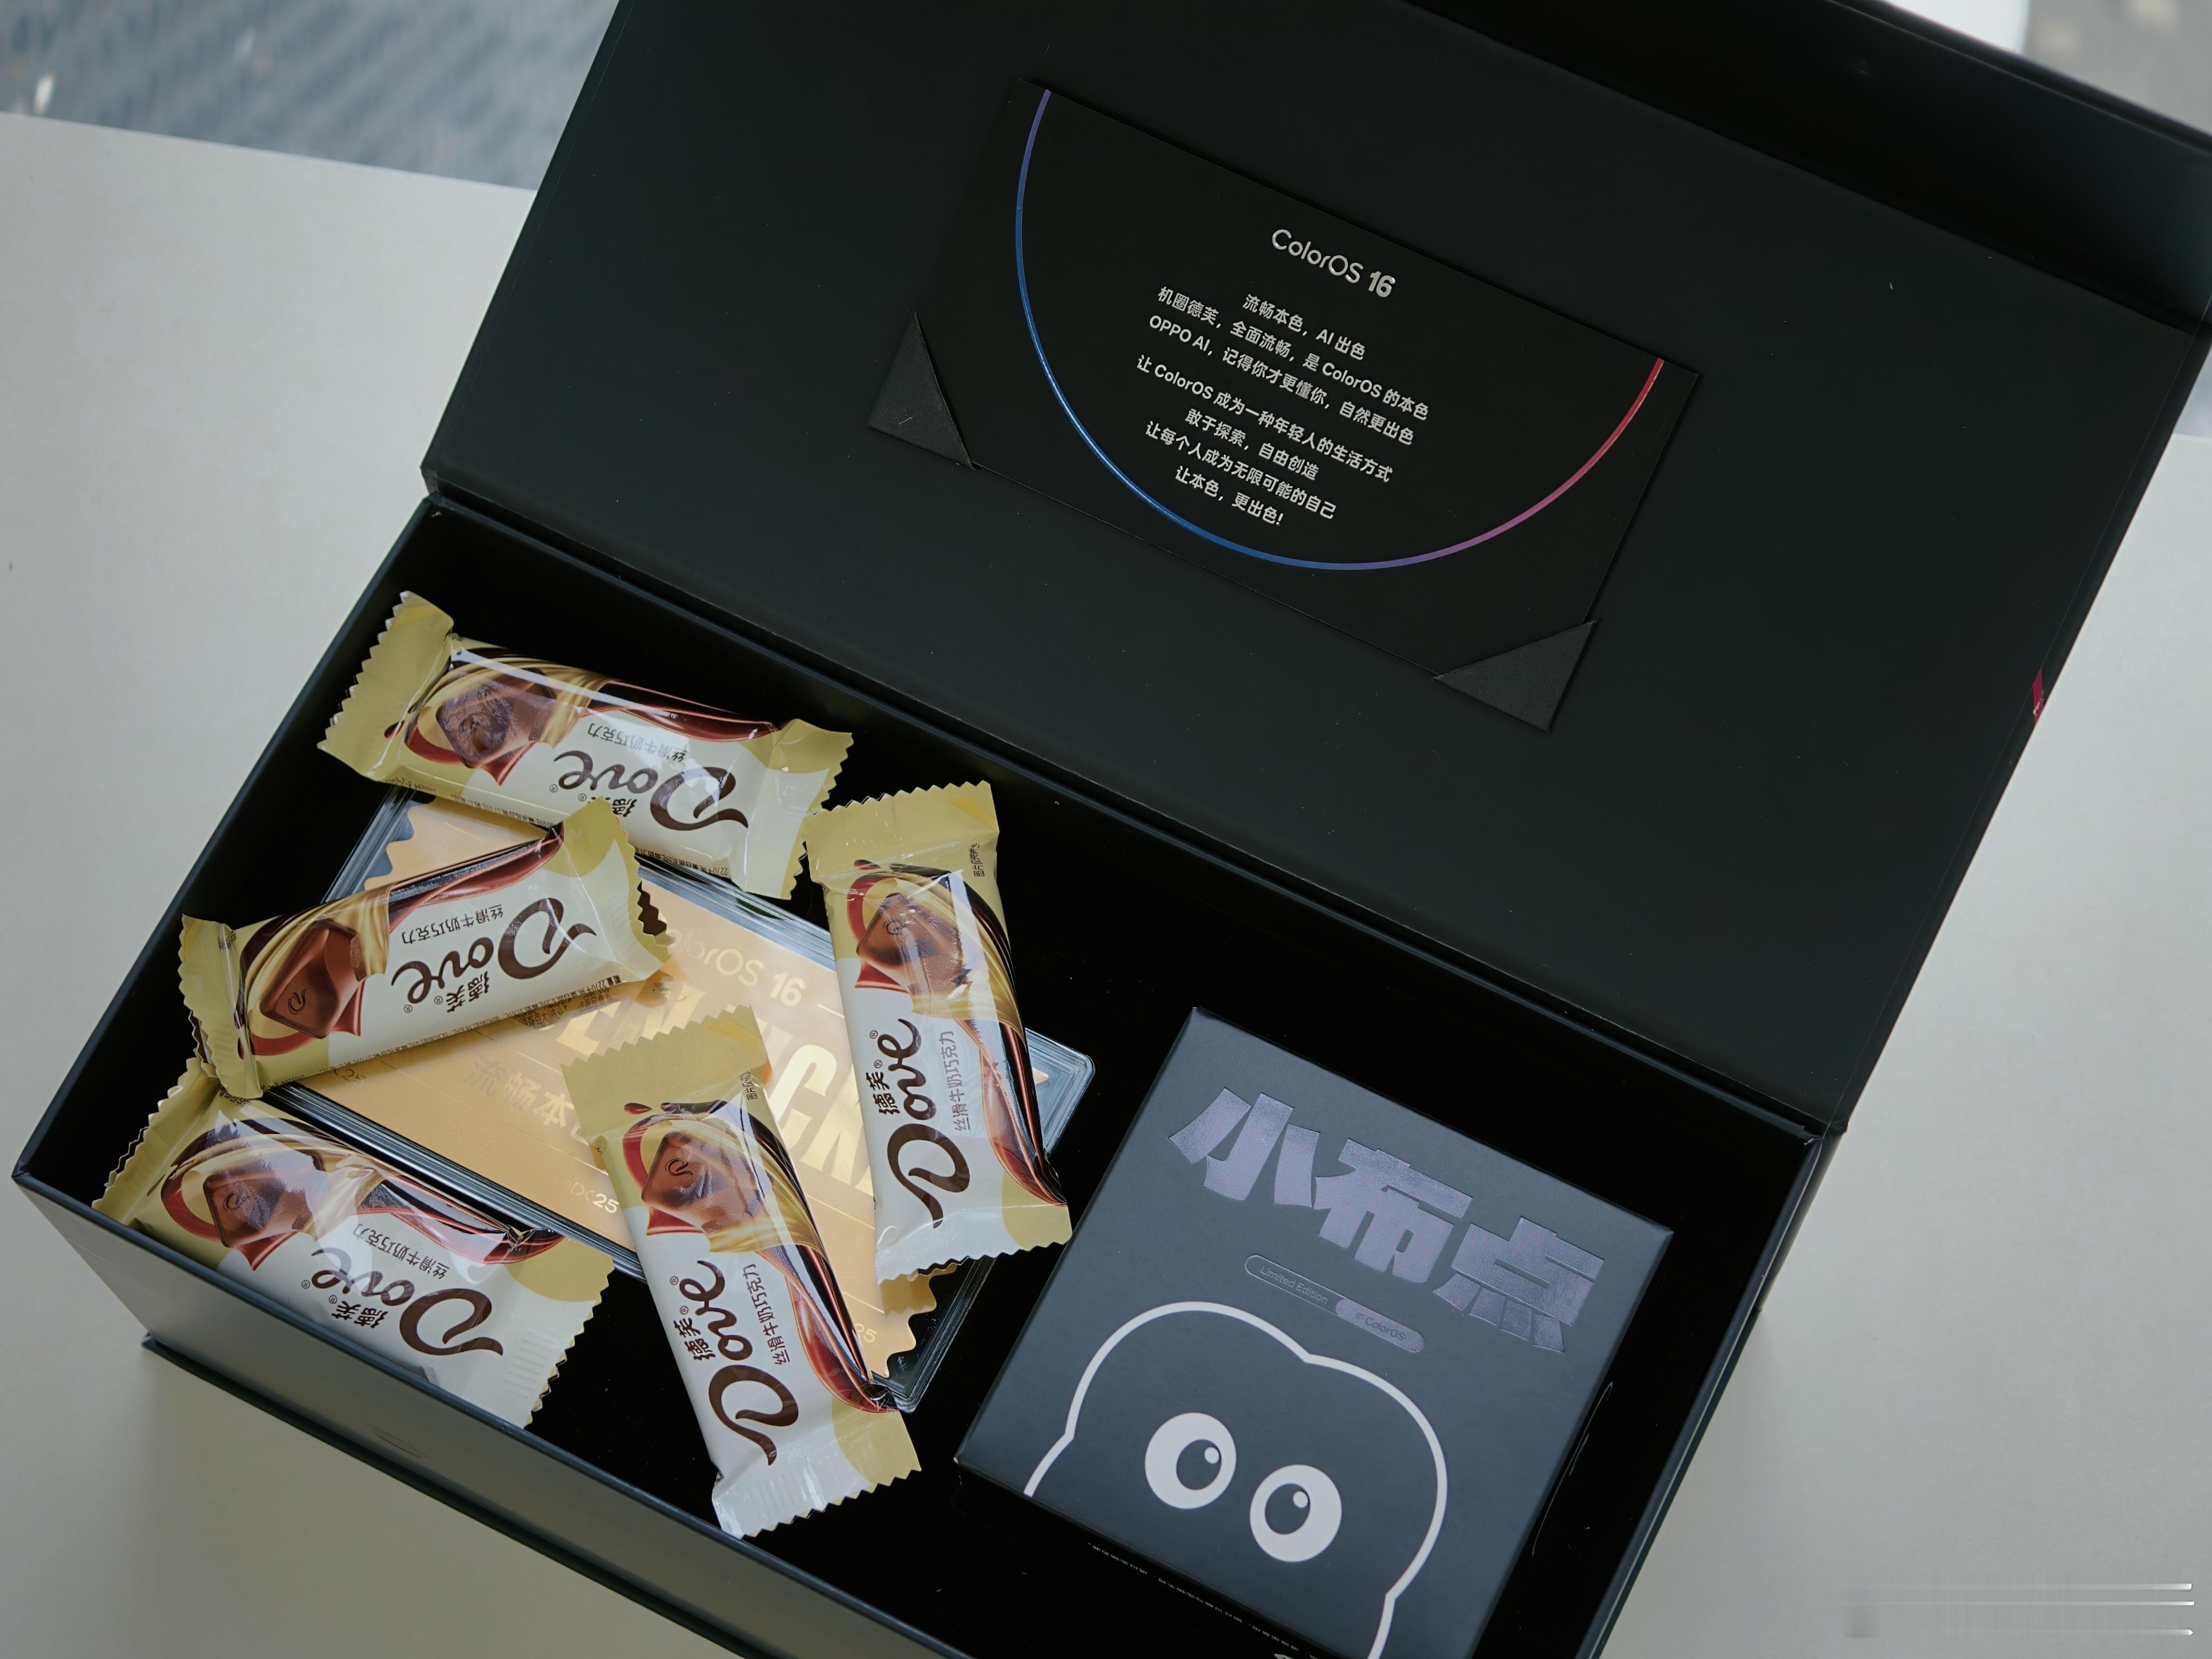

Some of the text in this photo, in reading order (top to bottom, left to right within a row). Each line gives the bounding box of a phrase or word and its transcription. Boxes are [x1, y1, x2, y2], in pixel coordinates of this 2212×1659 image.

[1271, 228, 1395, 298] ColorOS 16
[1149, 315, 1191, 342] OPPO
[1145, 421, 1337, 520] 让每个人成为无限可能的自己
[588, 723, 687, 762] 丝滑牛奶巧克力
[402, 904, 503, 945] 丝滑牛奶巧克力
[666, 929, 807, 1007] olorOS 16
[939, 1031, 970, 1131] 丝滑牛奶巧克力
[352, 1223, 450, 1279] 丝滑牛奶巧克力
[1168, 1087, 1604, 1352] 小布点
[743, 1264, 790, 1365] 丝滑牛奶巧克力
[1260, 1265, 1328, 1305] Limited Edition
[1365, 1316, 1405, 1341] ColorOS
